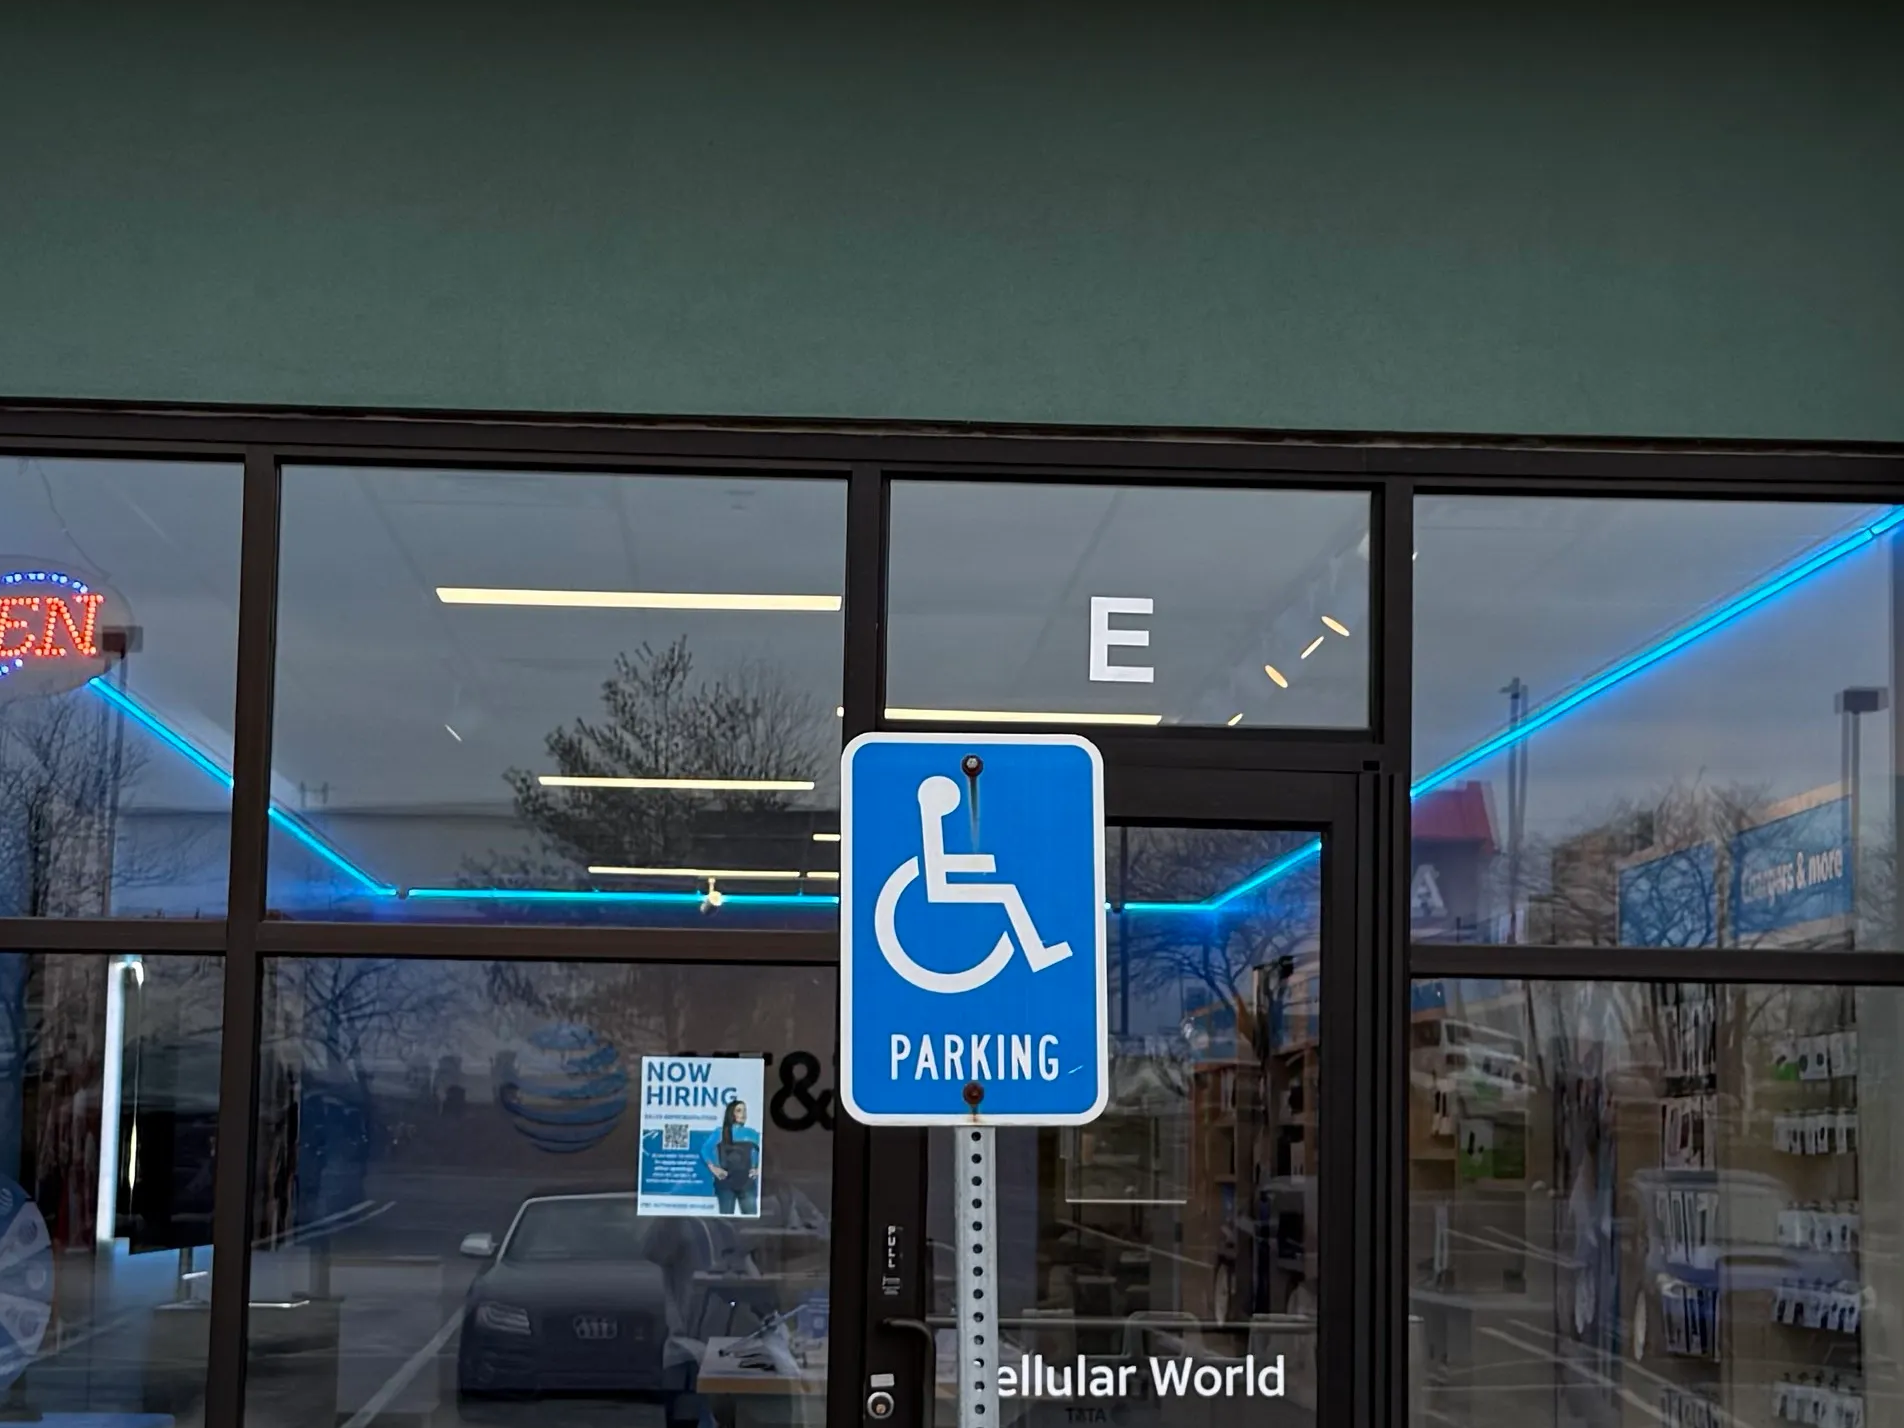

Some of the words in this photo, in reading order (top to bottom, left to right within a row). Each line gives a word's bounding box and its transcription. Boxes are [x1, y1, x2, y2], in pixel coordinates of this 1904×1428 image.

[1090, 596, 1155, 684] E
[647, 1061, 712, 1083] NOW
[891, 1034, 1060, 1081] PARKING
[646, 1085, 738, 1107] HIRING
[887, 1225, 896, 1269] PULL
[997, 1354, 1137, 1397] ellular
[1149, 1354, 1285, 1397] World
